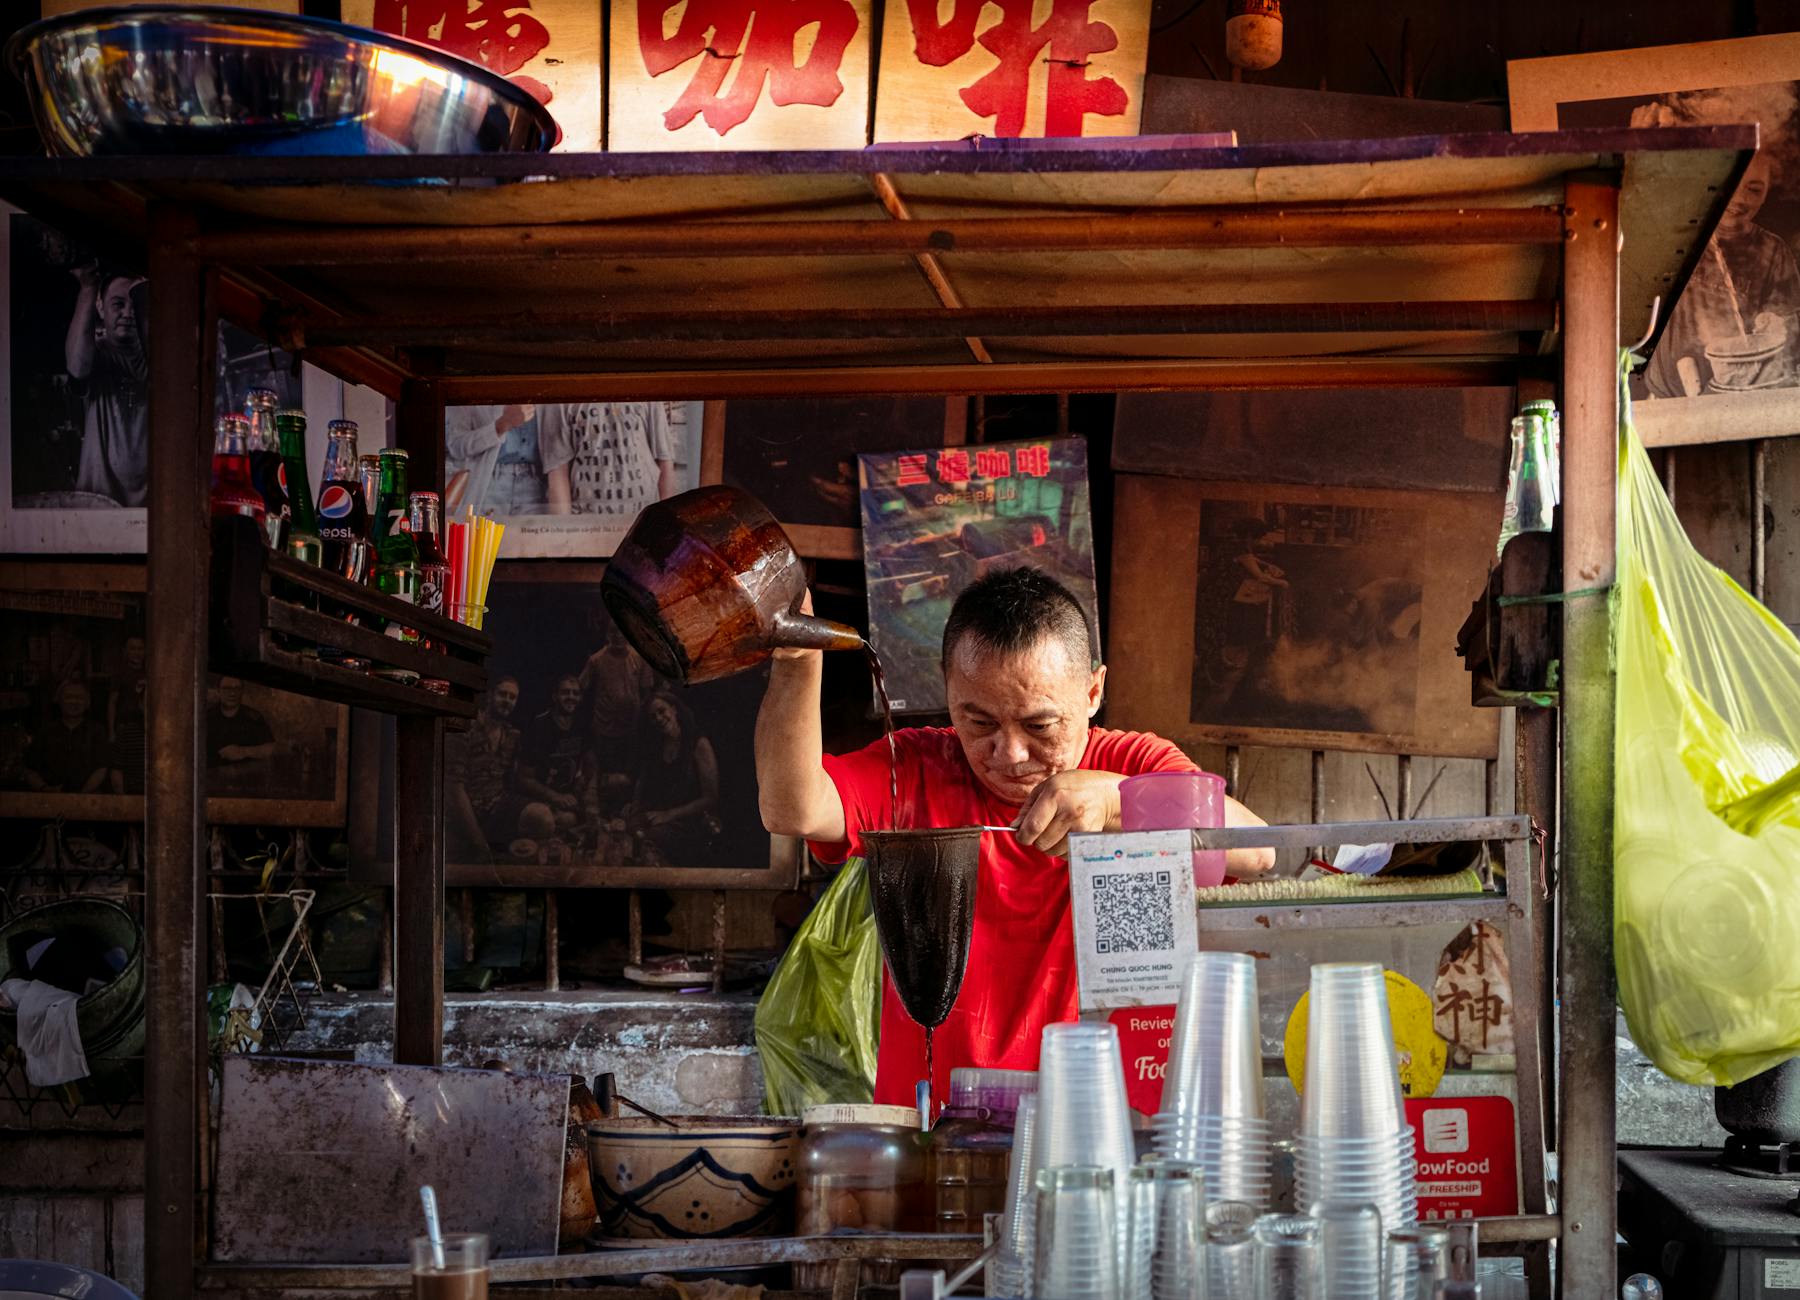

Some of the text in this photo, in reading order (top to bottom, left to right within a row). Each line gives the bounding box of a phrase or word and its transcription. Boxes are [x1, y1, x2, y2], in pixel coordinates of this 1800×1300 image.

[1100, 963, 1173, 974] CHUNG QUOC HUNG
[1429, 1184, 1479, 1193] FREESHIP
